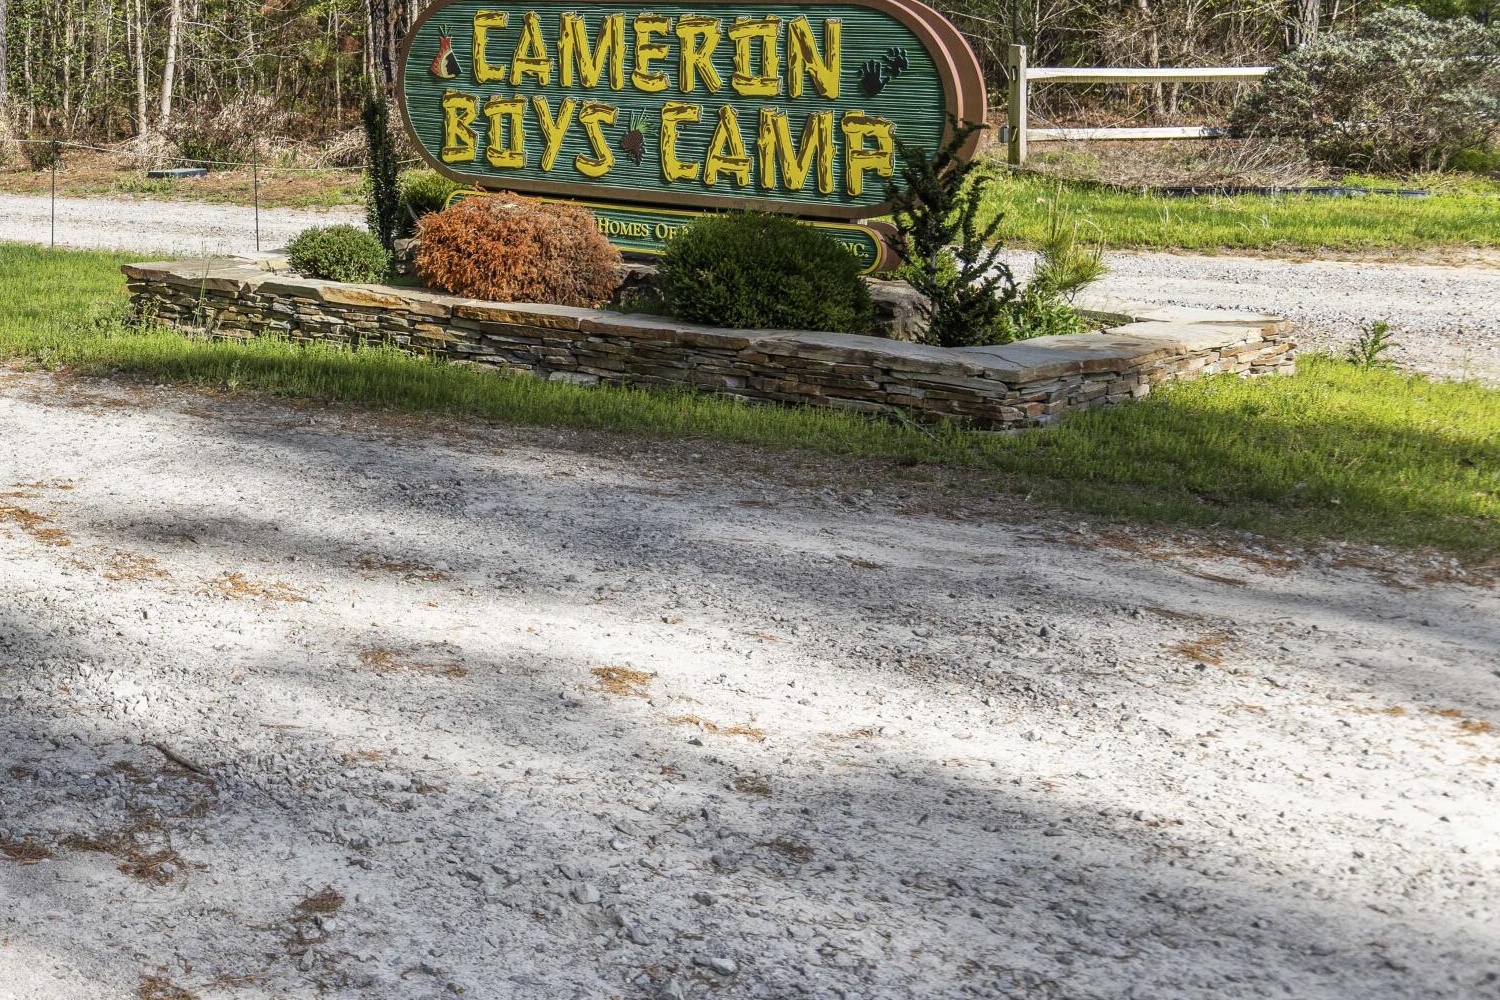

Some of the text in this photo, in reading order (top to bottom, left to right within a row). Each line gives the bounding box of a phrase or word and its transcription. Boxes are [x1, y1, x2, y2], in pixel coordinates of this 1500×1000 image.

[472, 9, 842, 99] CAMERON
[442, 88, 897, 196] BOYS CAMP
